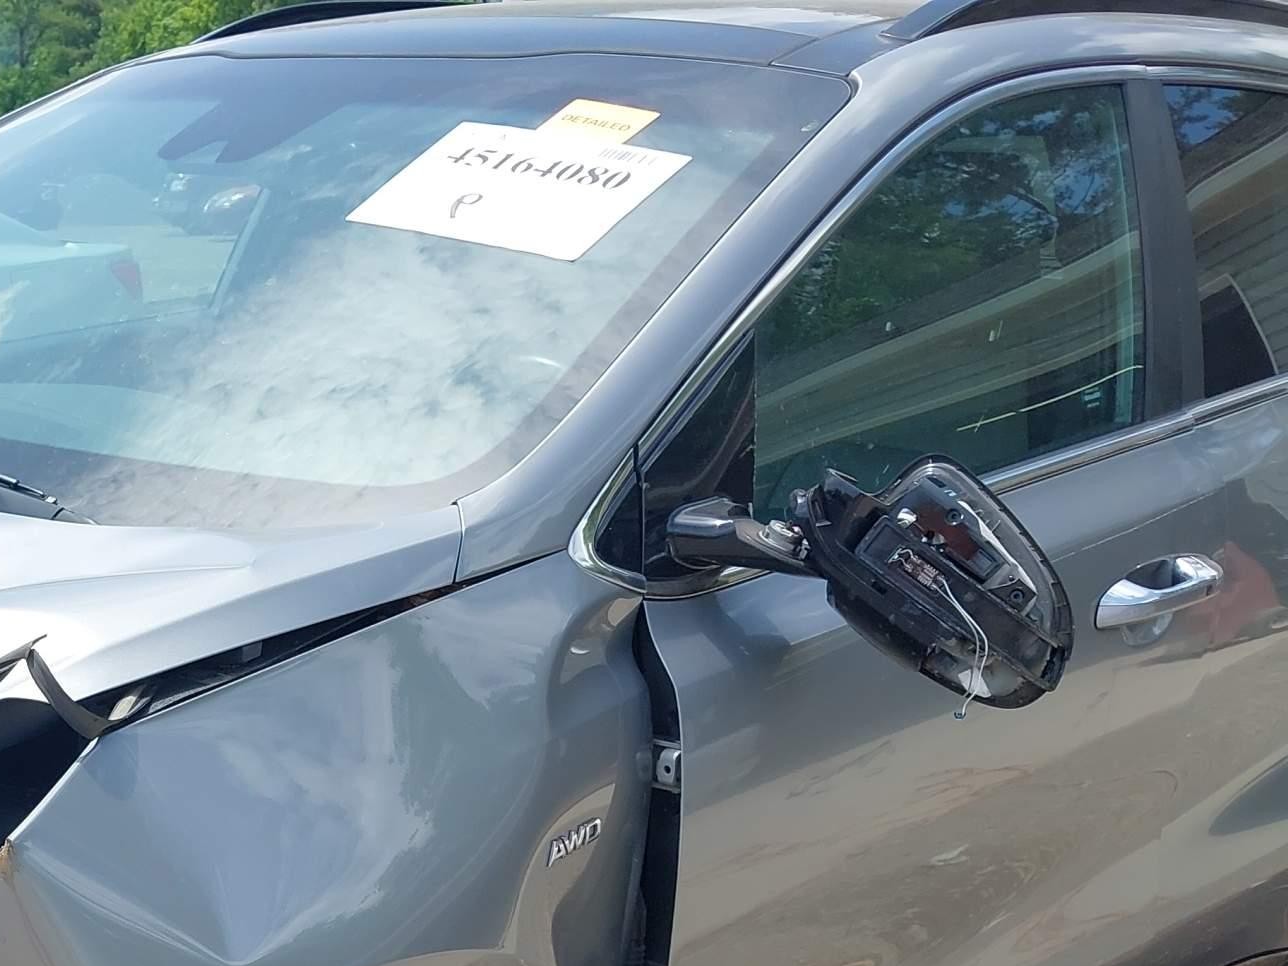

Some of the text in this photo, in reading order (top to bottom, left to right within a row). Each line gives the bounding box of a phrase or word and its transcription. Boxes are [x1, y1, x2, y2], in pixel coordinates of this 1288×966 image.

[560, 113, 631, 132] DETAILED
[447, 147, 632, 189] 45164080
[545, 818, 601, 868] AWD
